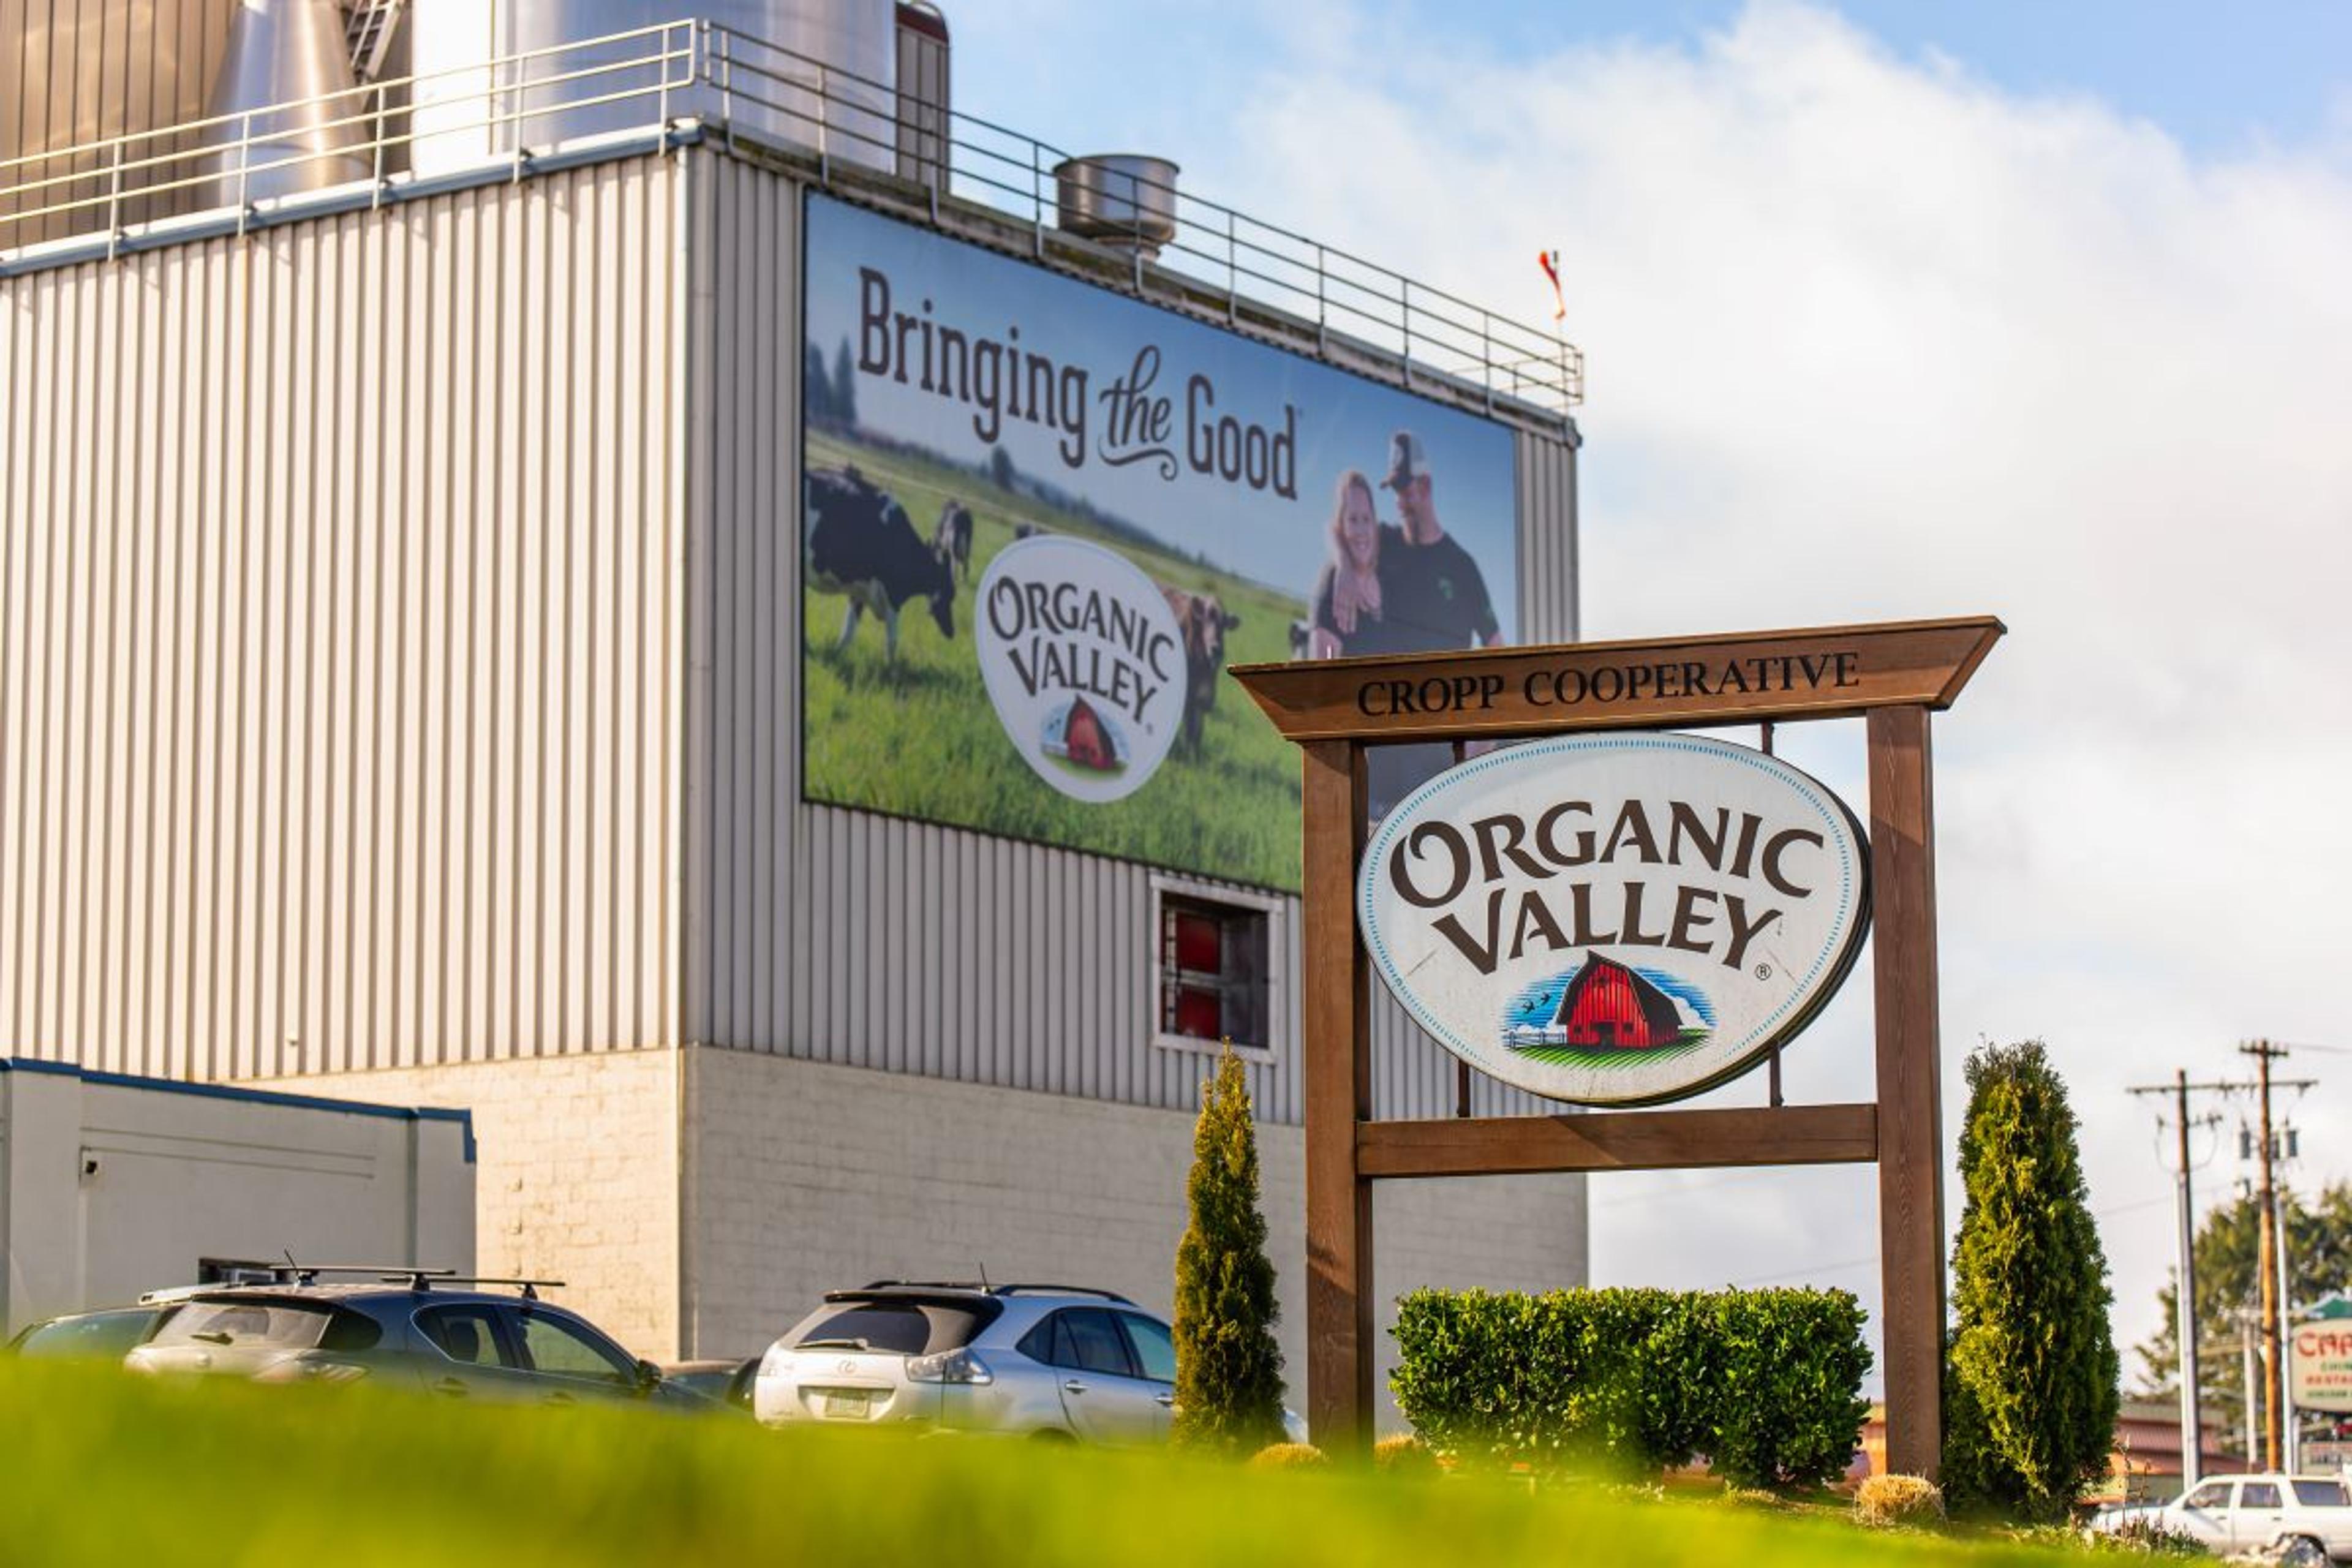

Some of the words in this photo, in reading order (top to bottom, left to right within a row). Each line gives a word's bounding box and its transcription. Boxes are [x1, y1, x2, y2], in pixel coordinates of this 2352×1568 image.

[859, 267, 1088, 469] Bringing
[1099, 345, 1178, 481] the
[1187, 374, 1297, 501] Good
[988, 575, 1174, 682] ORGANIC
[1008, 636, 1156, 724] VALLEY
[1358, 676, 1504, 717] CROPP
[1524, 652, 1860, 707] COOPERATIVE
[1389, 799, 1824, 908] ORGANIC
[1431, 881, 1783, 975] VALLEY
